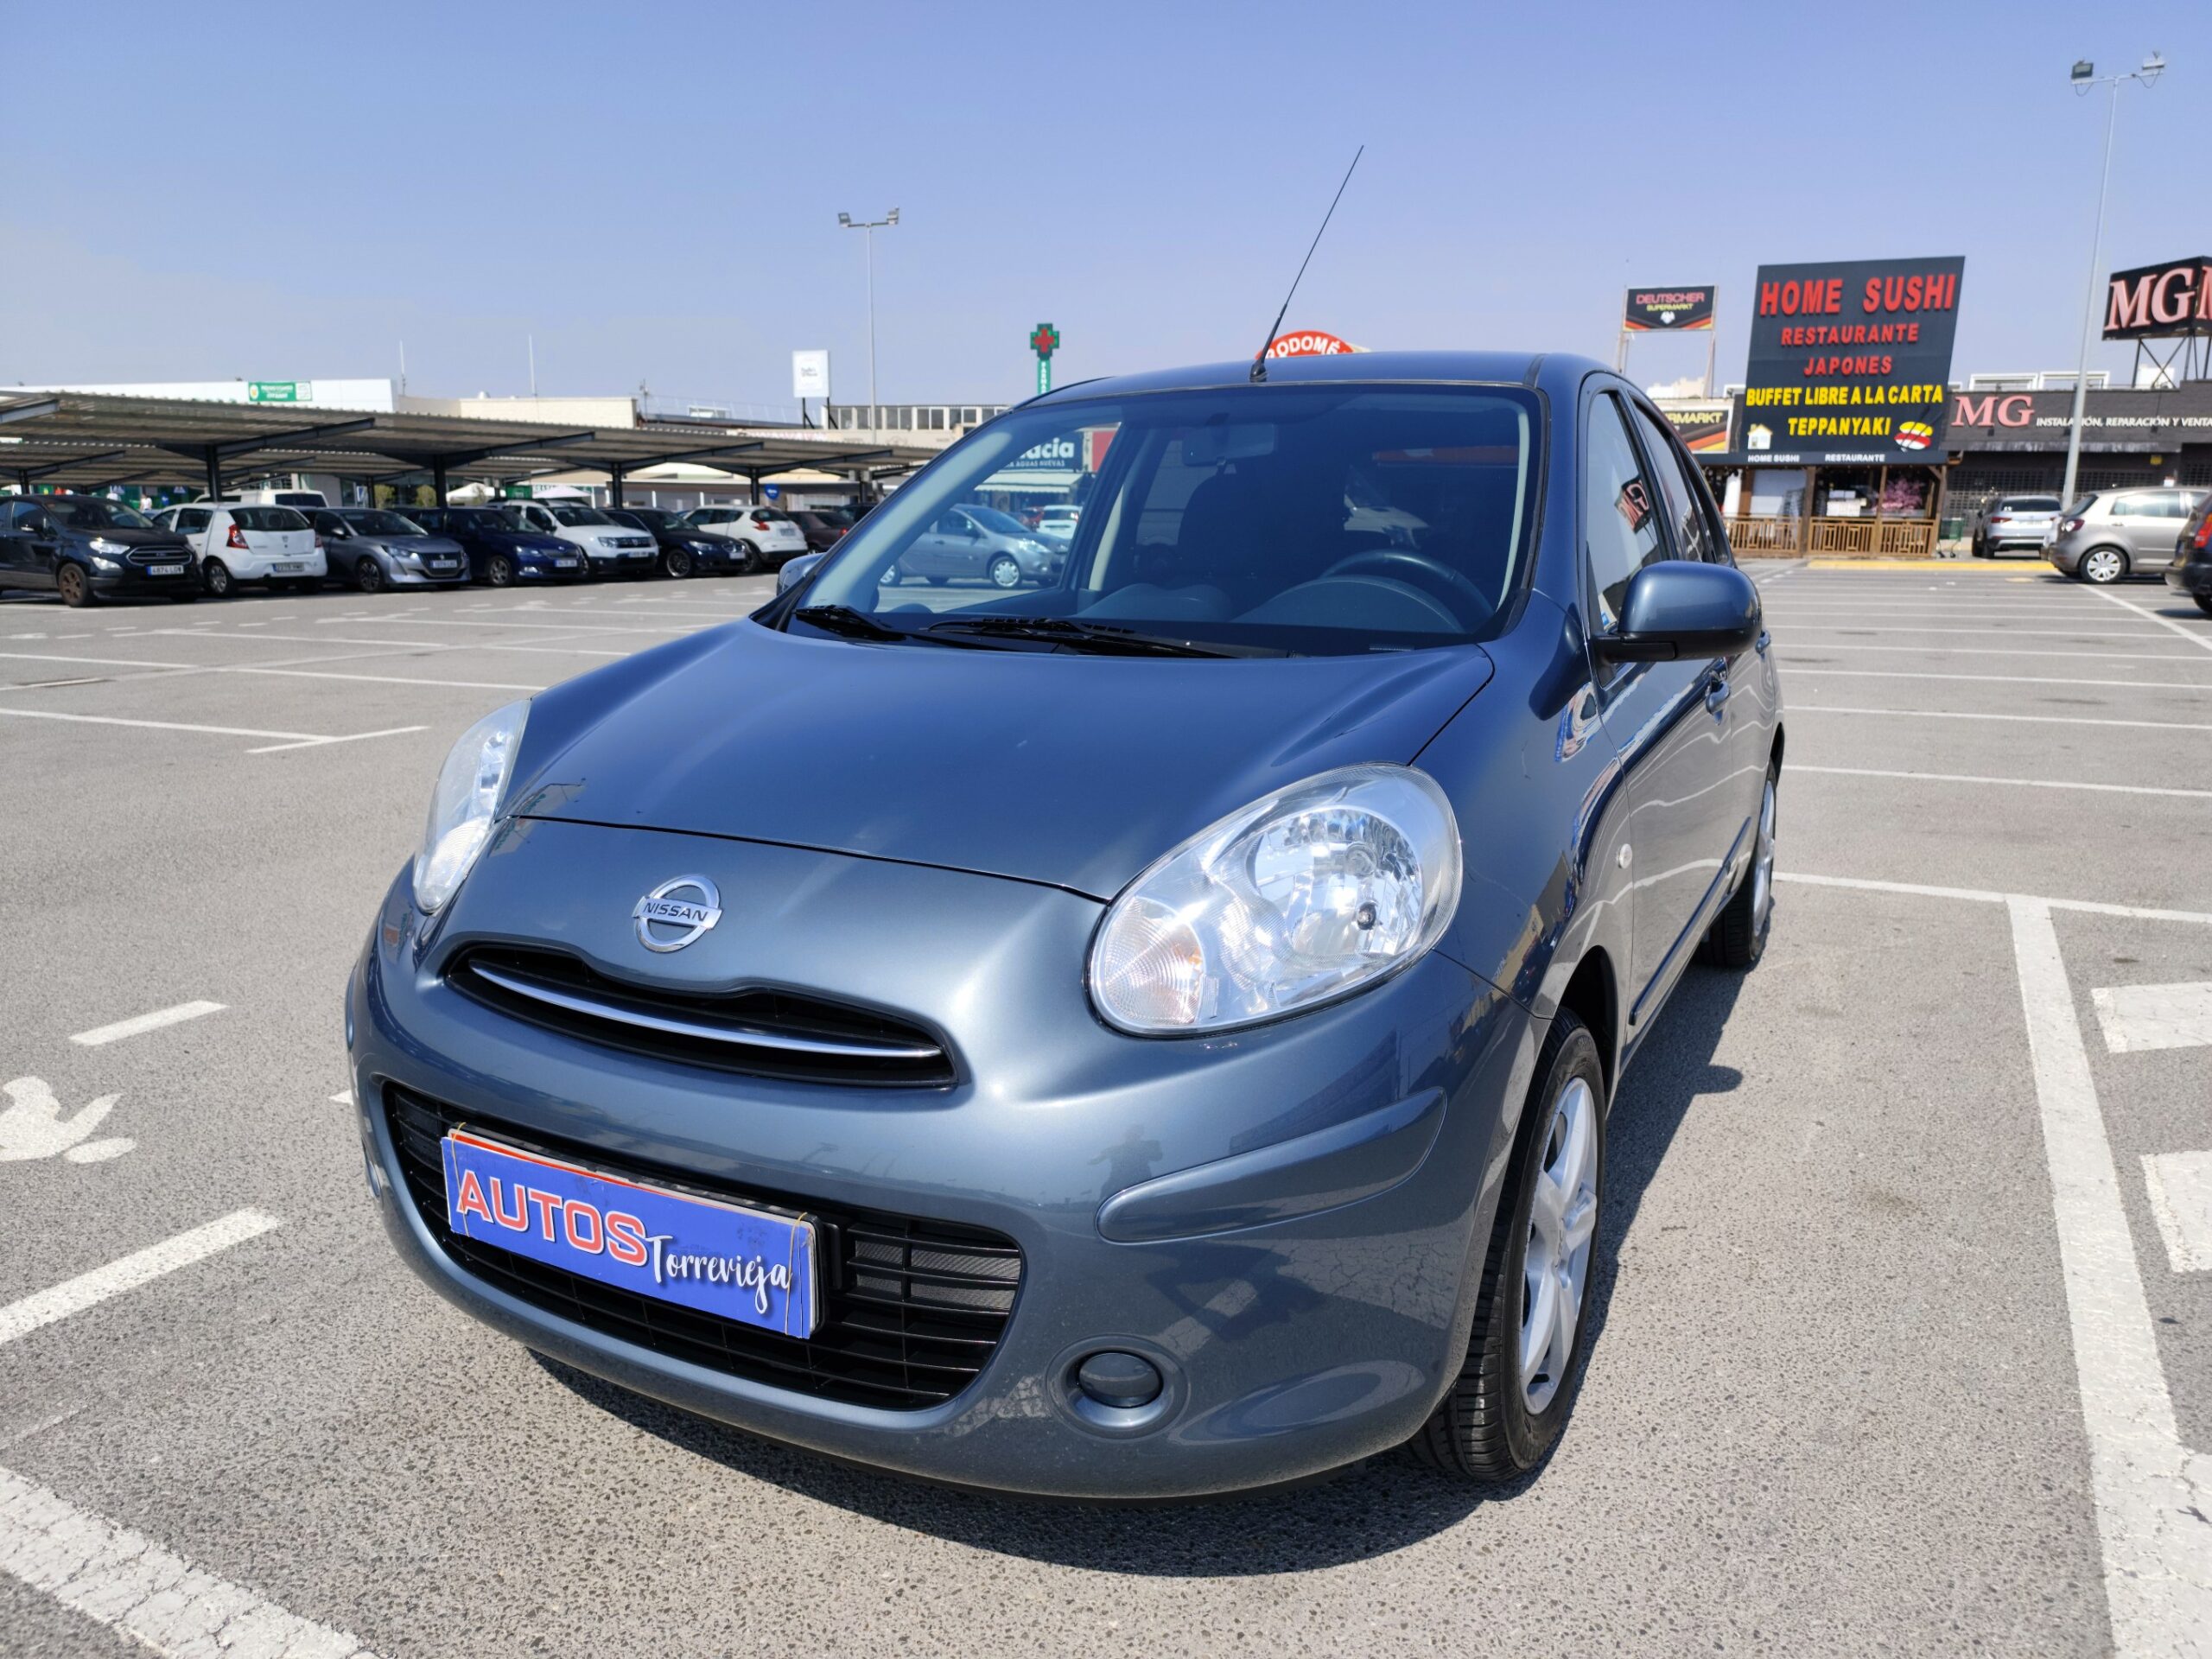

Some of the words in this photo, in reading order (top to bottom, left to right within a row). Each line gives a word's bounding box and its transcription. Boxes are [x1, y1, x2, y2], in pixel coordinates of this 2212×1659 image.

[1636, 292, 1705, 304] DEUTSCHER
[1759, 279, 1843, 315] HOME
[1863, 274, 1955, 313] SUSHI
[2104, 267, 2196, 331] MG
[1781, 323, 1919, 346] RESTAURANTE
[1804, 356, 1892, 376] JAPONES
[1746, 387, 1802, 406] BUFFET
[1805, 386, 1848, 405] LIBRE
[1850, 386, 1861, 404] A
[1865, 385, 1885, 404] LA
[1888, 385, 1942, 404] CARTA
[1950, 395, 2035, 427] MG
[2036, 415, 2103, 428] INSTALAIÓN,
[2106, 415, 2169, 427] REPARACIÓN
[2172, 416, 2180, 427] Y
[1788, 417, 1891, 436] TEPPANYAKI
[1020, 437, 1074, 459] acia
[1825, 454, 1885, 462] RESTAURANTE
[643, 902, 708, 922] NISSAN
[456, 1169, 648, 1267] AUTOS
[645, 1235, 792, 1314] Torrevieja
